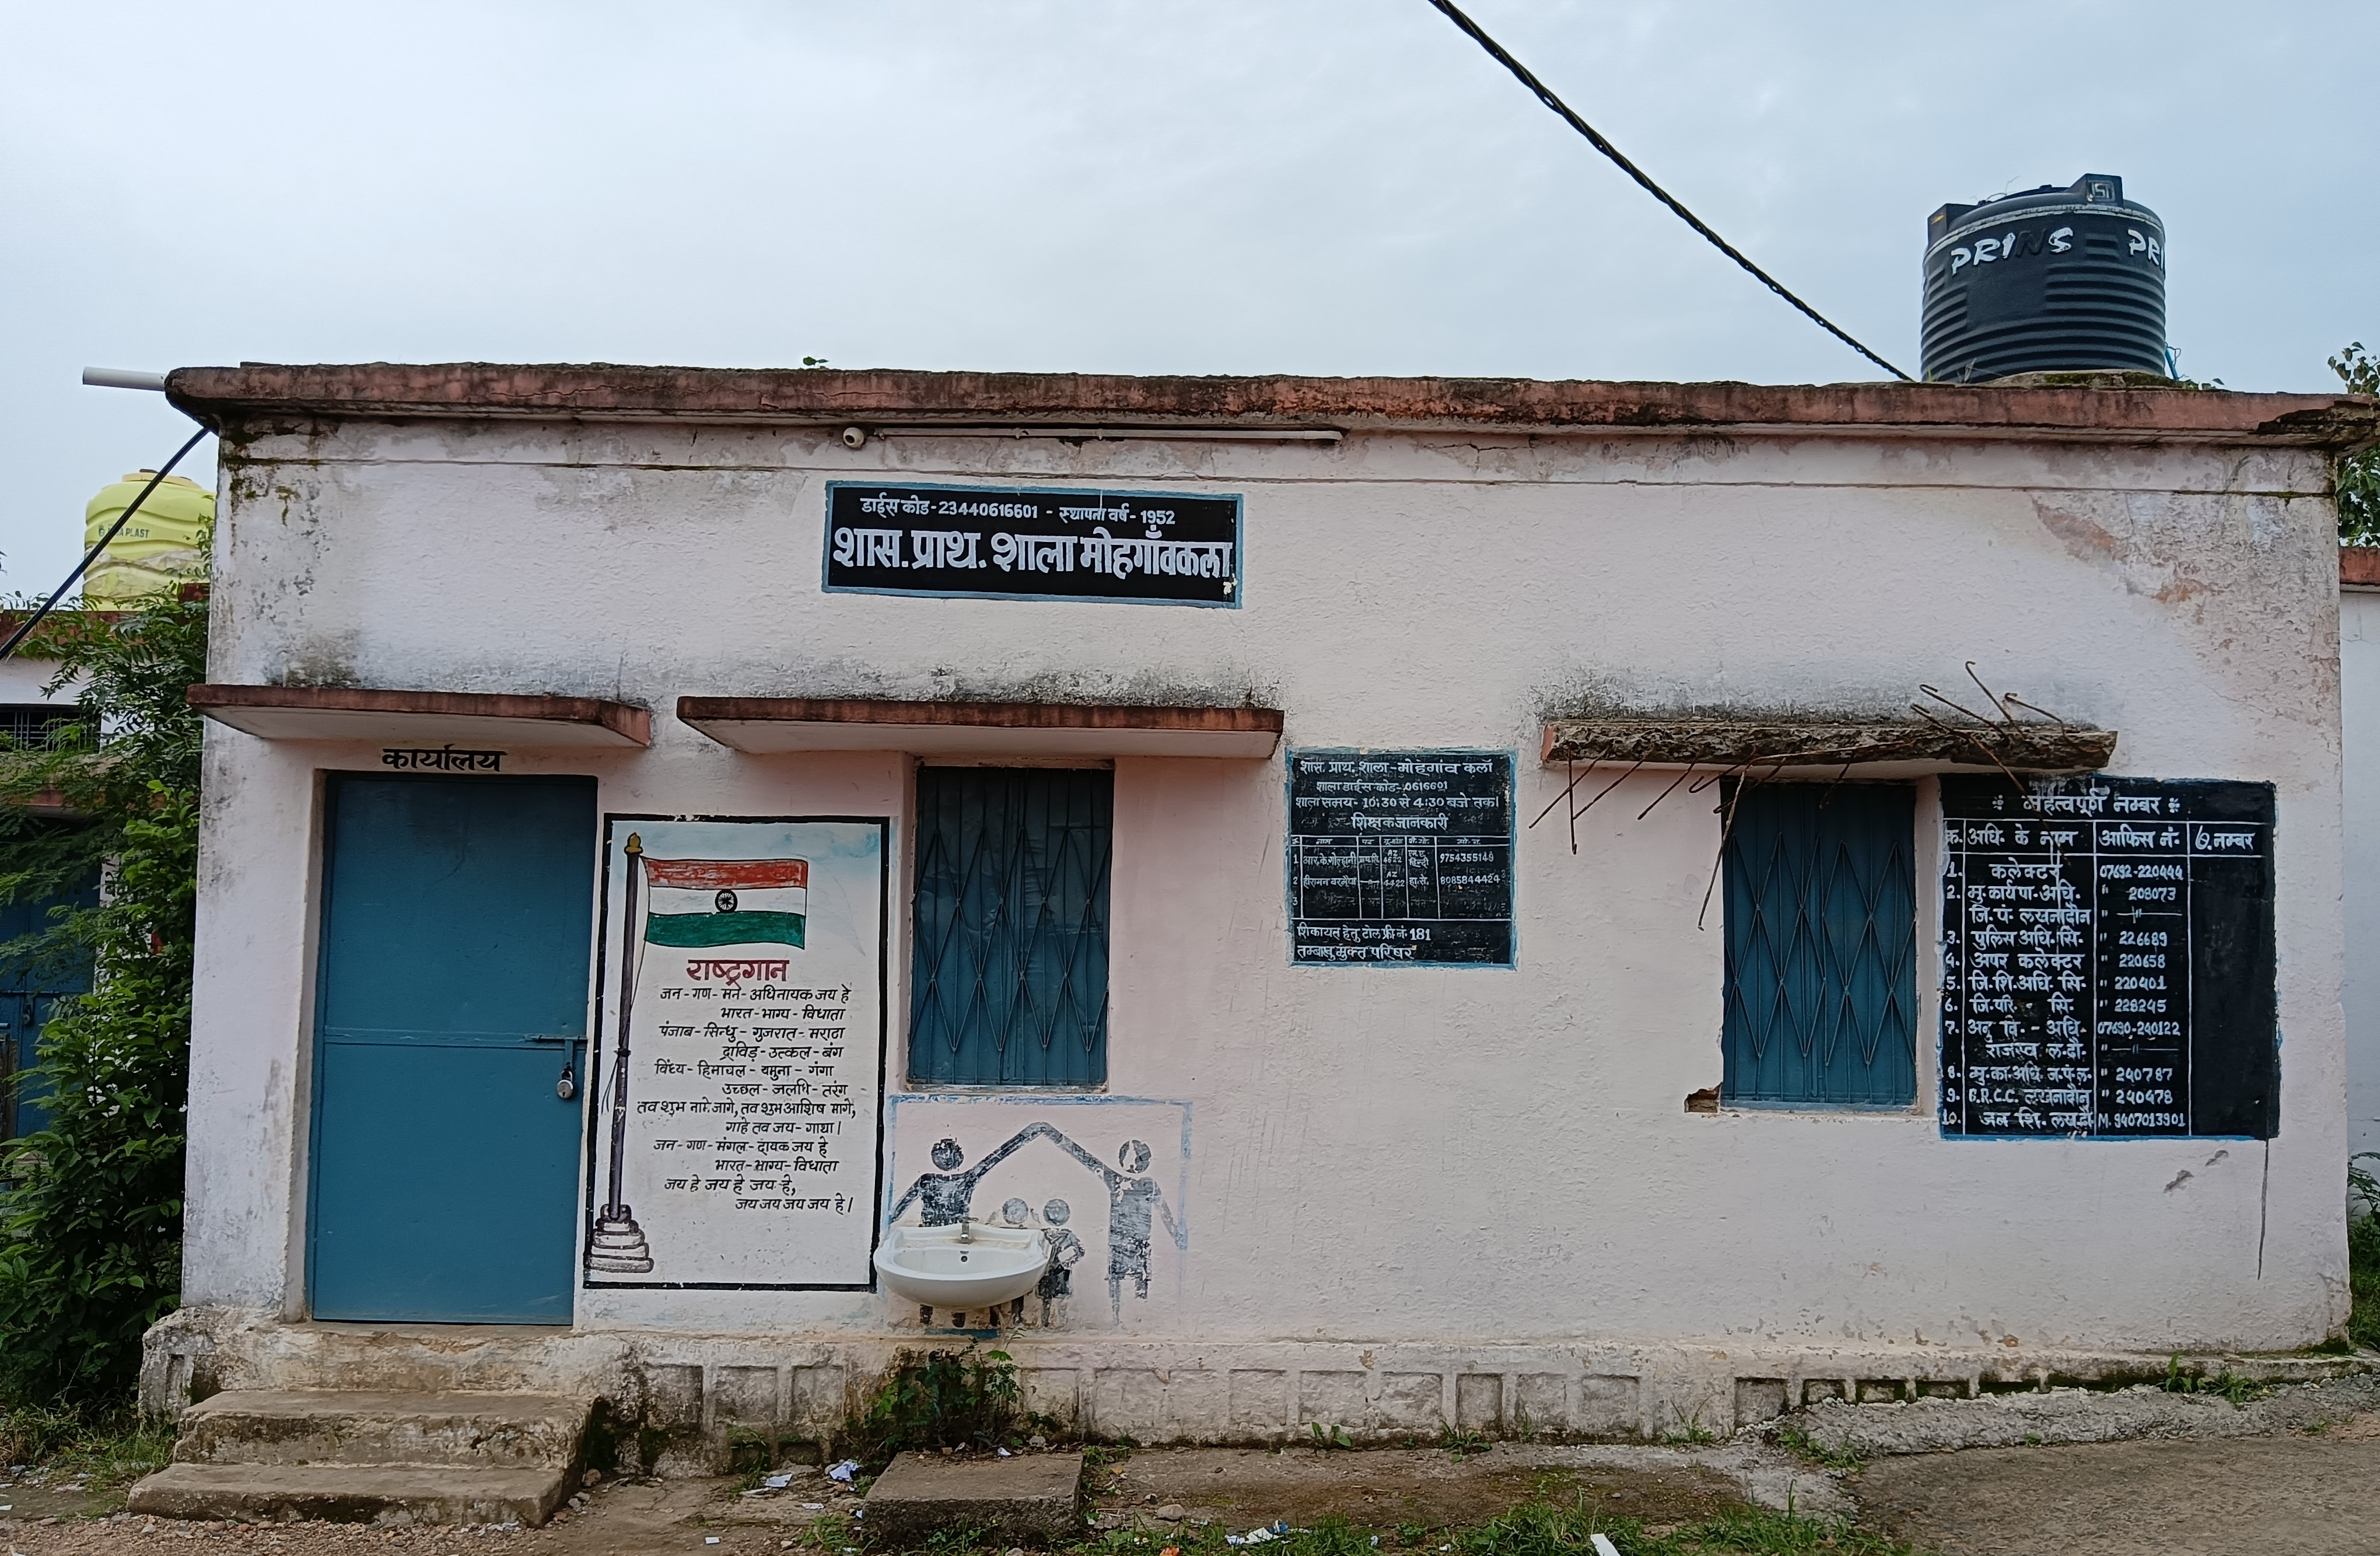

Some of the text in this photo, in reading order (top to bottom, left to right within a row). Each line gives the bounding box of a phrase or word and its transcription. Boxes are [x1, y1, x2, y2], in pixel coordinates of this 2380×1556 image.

[860, 492, 900, 518] डाईस
[939, 501, 1038, 518] 23440616601
[1140, 509, 1175, 525] 1952
[834, 527, 908, 568] शास.
[911, 530, 986, 569] प्राथ.
[991, 532, 1077, 574] शाला
[382, 743, 508, 772] कार्यालय
[1329, 761, 1355, 773] प्राथ.
[1317, 781, 1342, 792] शाला
[1342, 779, 1374, 793] डाईस
[1405, 781, 1447, 792] 0616601
[1296, 797, 1321, 809] शाला
[1399, 793, 1410, 809] से
[1413, 798, 1444, 807] 4:30
[1446, 792, 1471, 808] बजे
[2113, 796, 2162, 815] नम्बर
[2015, 823, 2030, 845] के
[2040, 831, 2078, 847] नाम
[2098, 824, 2156, 849] आफिस
[2213, 832, 2256, 851] नम्बर
[1989, 856, 2063, 879] कलेक्टर
[1297, 922, 1340, 940] शिकायत
[1342, 925, 1360, 943] हेतु
[1362, 925, 1381, 939] टोल
[1409, 928, 1432, 940] 181
[1971, 924, 2018, 950] पुलिस
[2119, 931, 2167, 946] 226689
[1969, 952, 2009, 969] अपर
[2017, 946, 2085, 971] कलेक्टर
[2119, 953, 2165, 968] 220658
[686, 960, 790, 988] राष्ट्रगान
[2115, 975, 2167, 991] 220401
[750, 984, 852, 1003] अधिनायक जय हे
[802, 1004, 846, 1021] विधाता
[2115, 998, 2166, 1014] 228245
[808, 1027, 846, 1041] मराठा
[822, 1042, 844, 1057] बंग
[808, 1061, 834, 1076] गंगा
[2116, 1067, 2172, 1083] 240787
[822, 1080, 848, 1097] तरंग
[2116, 1089, 2173, 1104] 240478
[637, 1102, 660, 1114] तव
[741, 1103, 760, 1114] तव
[783, 1098, 826, 1116] आशिष
[726, 1117, 750, 1134] गाहे
[752, 1122, 772, 1134] तव
[757, 1141, 789, 1156] दायक
[792, 1142, 814, 1152] जय
[818, 1135, 828, 1158] हे
[793, 1156, 839, 1174] विधाता
[664, 1179, 688, 1190] जय
[690, 1174, 701, 1192] हे
[705, 1179, 732, 1190] जय
[733, 1174, 745, 1195] हे
[750, 1180, 777, 1190] जय
[736, 1199, 760, 1209] जय
[760, 1199, 782, 1209] जय
[783, 1199, 806, 1209] जय
[807, 1199, 831, 1209] जय
